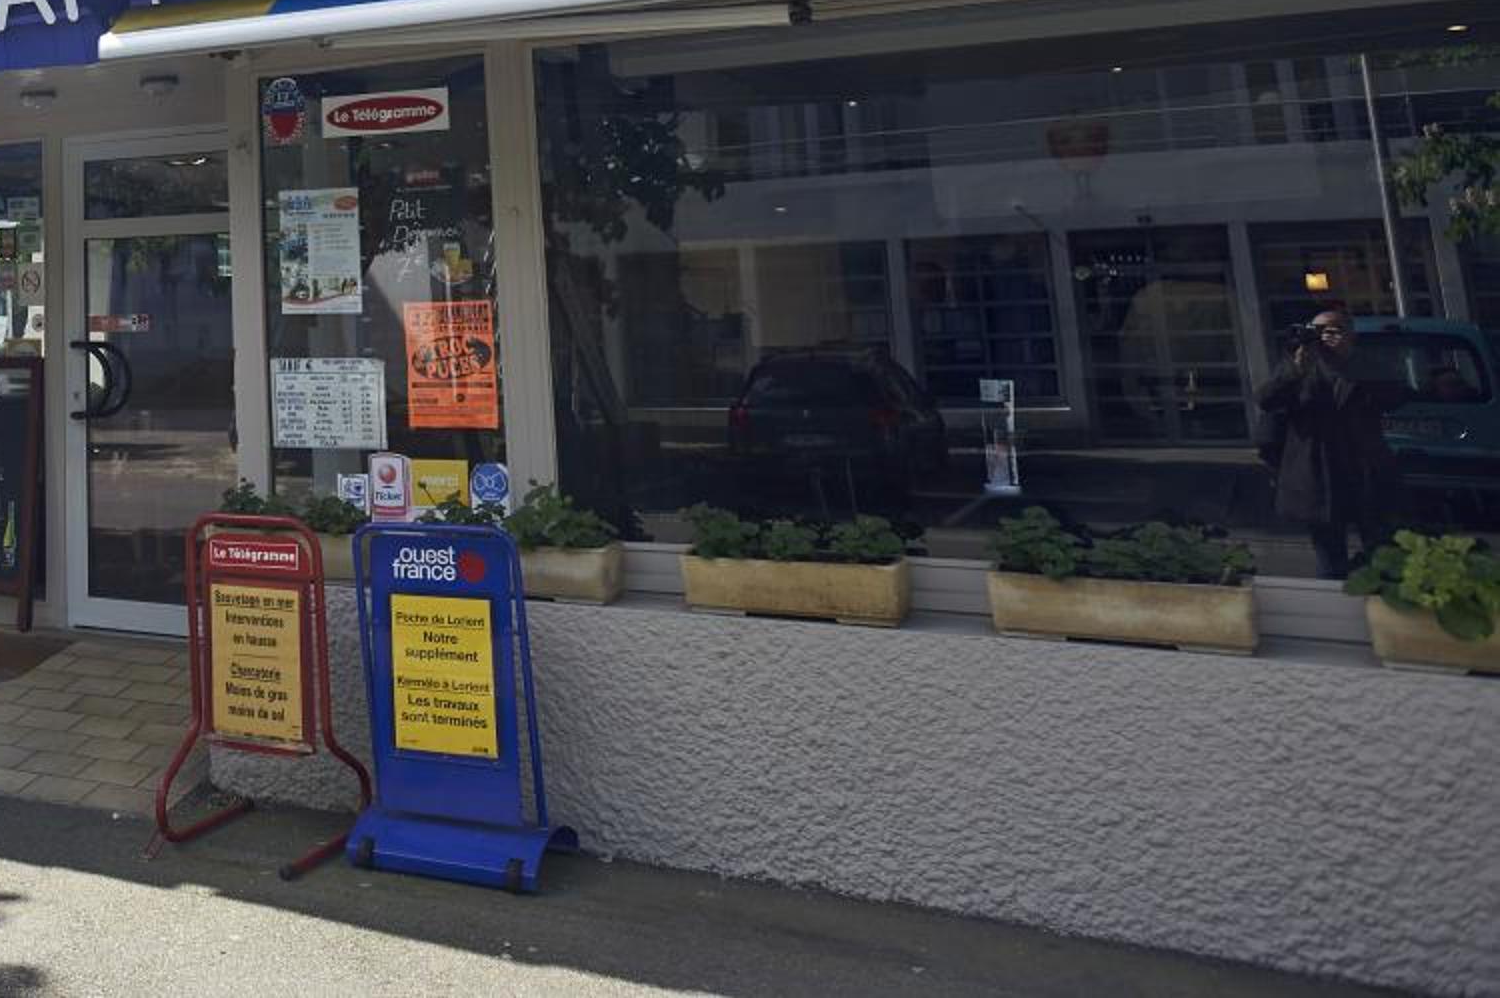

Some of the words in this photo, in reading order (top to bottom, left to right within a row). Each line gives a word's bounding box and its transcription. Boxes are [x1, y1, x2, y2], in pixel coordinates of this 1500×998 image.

[334, 110, 349, 123] Le
[353, 103, 436, 123] Télégramme
[399, 545, 457, 564] ouest
[392, 558, 457, 582] france
[423, 631, 459, 645] Notre
[404, 647, 479, 664] supplément
[407, 693, 431, 708] Les
[433, 695, 479, 712] travaux
[401, 709, 429, 723] sont
[431, 711, 488, 730] terminés
